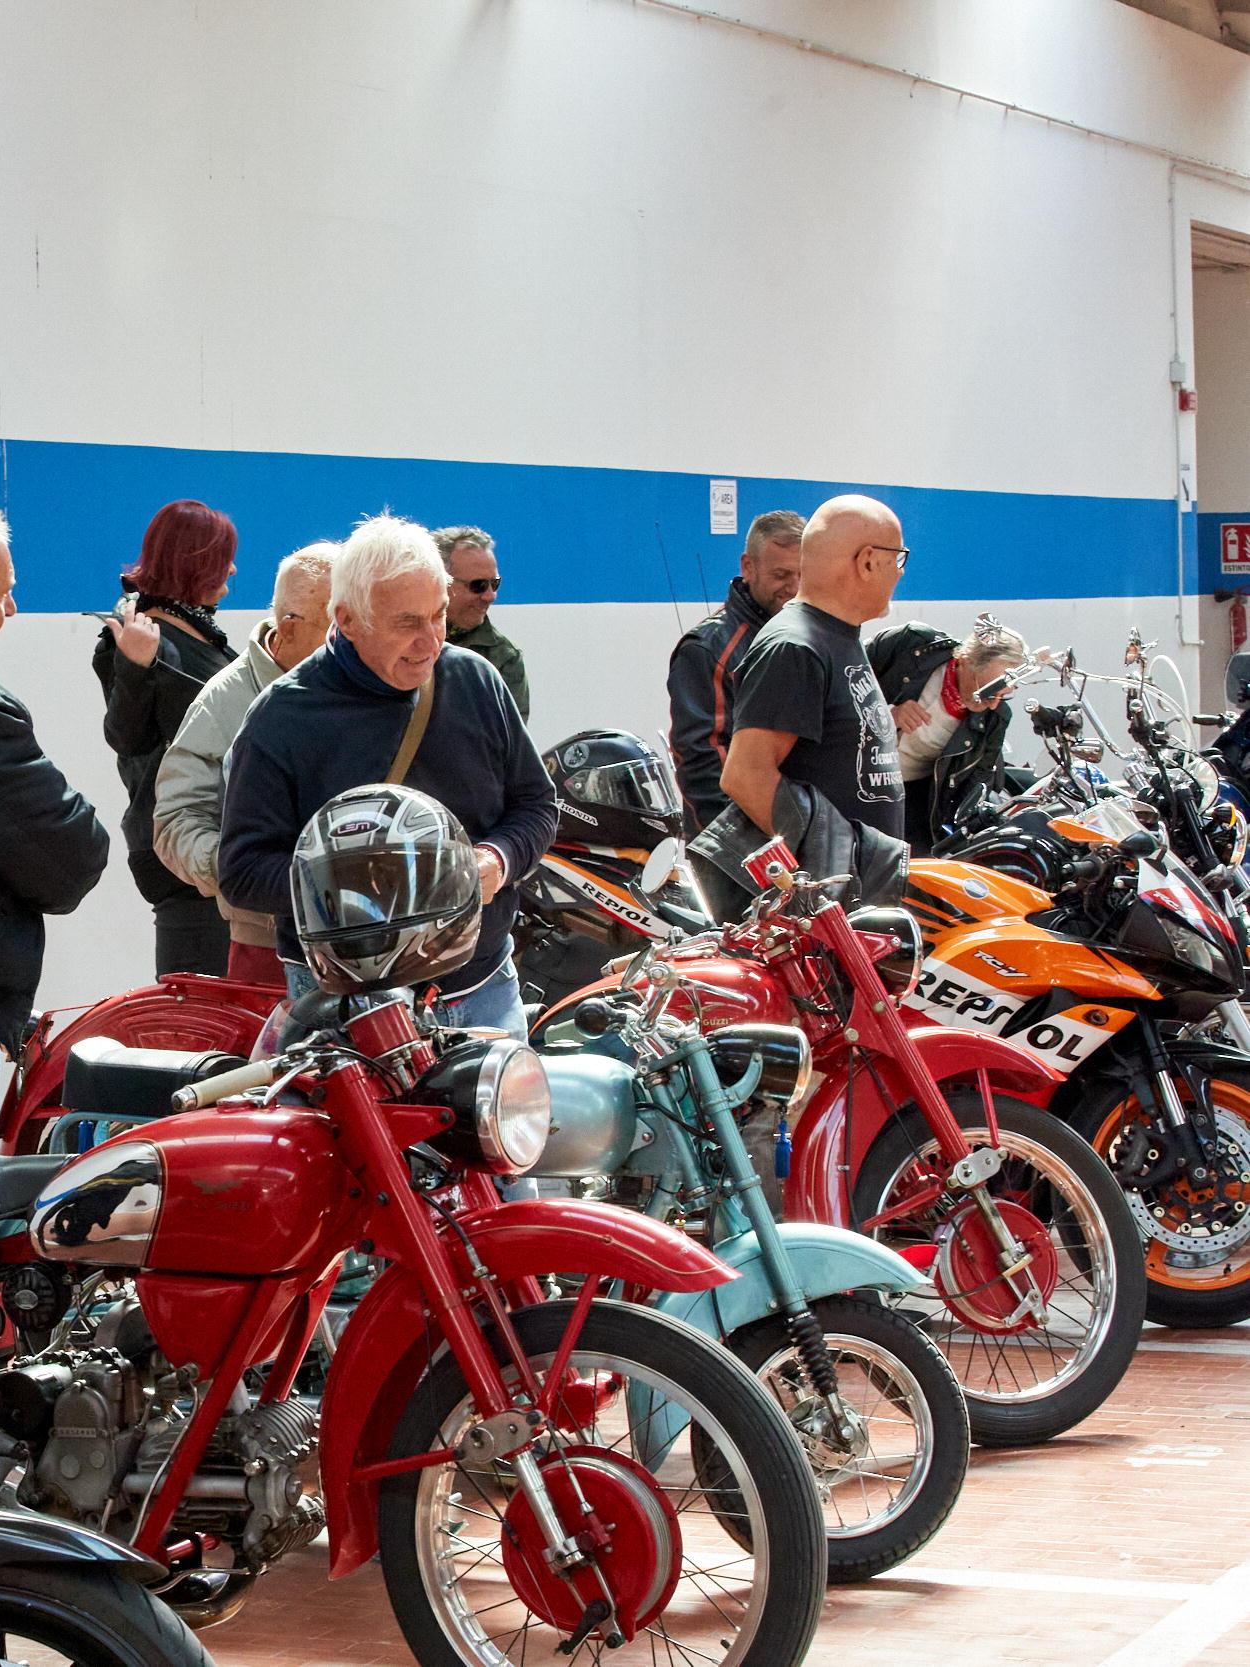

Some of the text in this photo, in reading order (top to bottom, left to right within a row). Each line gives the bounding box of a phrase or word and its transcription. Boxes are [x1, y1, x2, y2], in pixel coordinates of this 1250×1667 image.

[561, 803, 597, 824] HONDA
[582, 881, 652, 928] REPSOL
[702, 1017, 729, 1027] GUZZI
